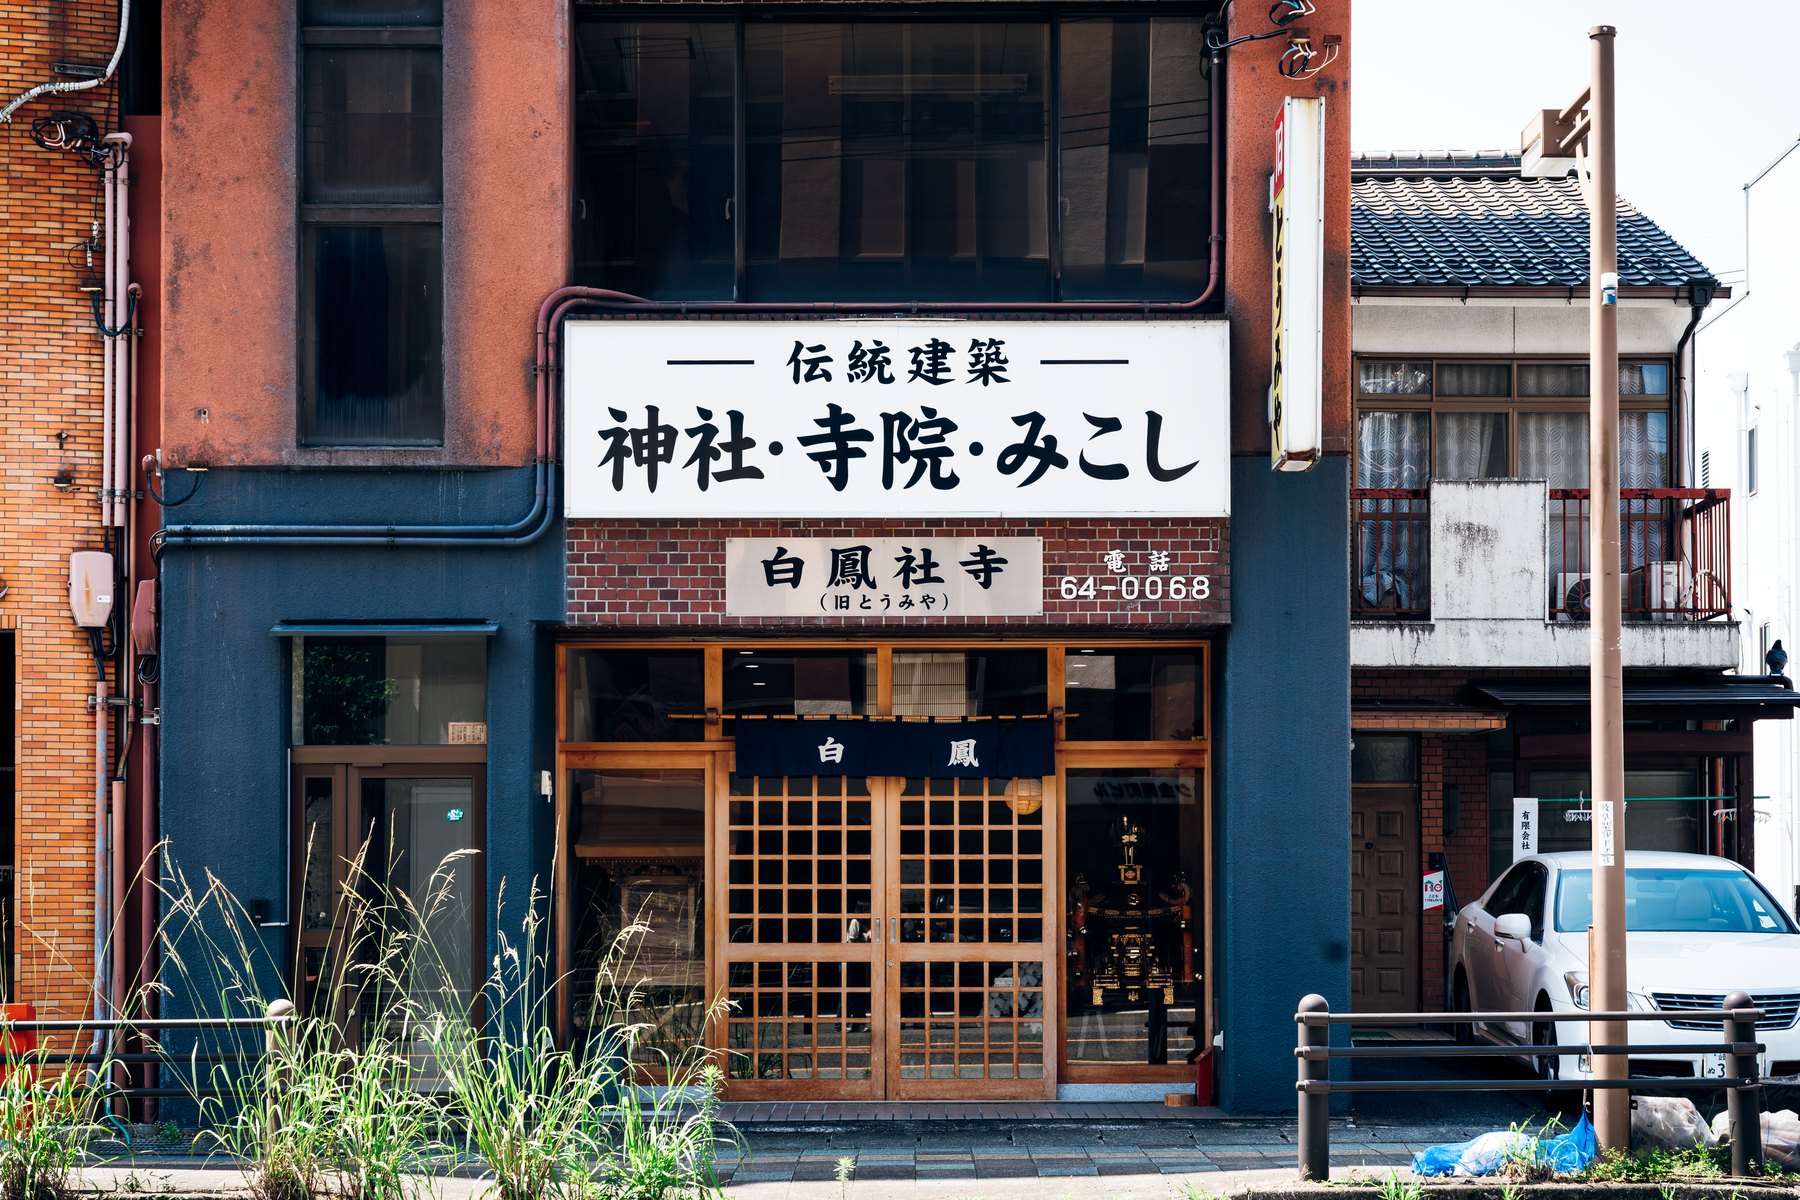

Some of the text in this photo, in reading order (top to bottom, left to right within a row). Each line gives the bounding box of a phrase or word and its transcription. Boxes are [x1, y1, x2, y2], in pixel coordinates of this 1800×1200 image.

[785, 337, 1011, 387] 伝統建築
[597, 402, 1200, 494] 神社・寺院・みこし
[760, 544, 1009, 590] 白鳳社寺
[1102, 549, 1170, 573] 電話
[1059, 576, 1211, 601] 64-0068
[1521, 810, 1531, 851] 有限会社
